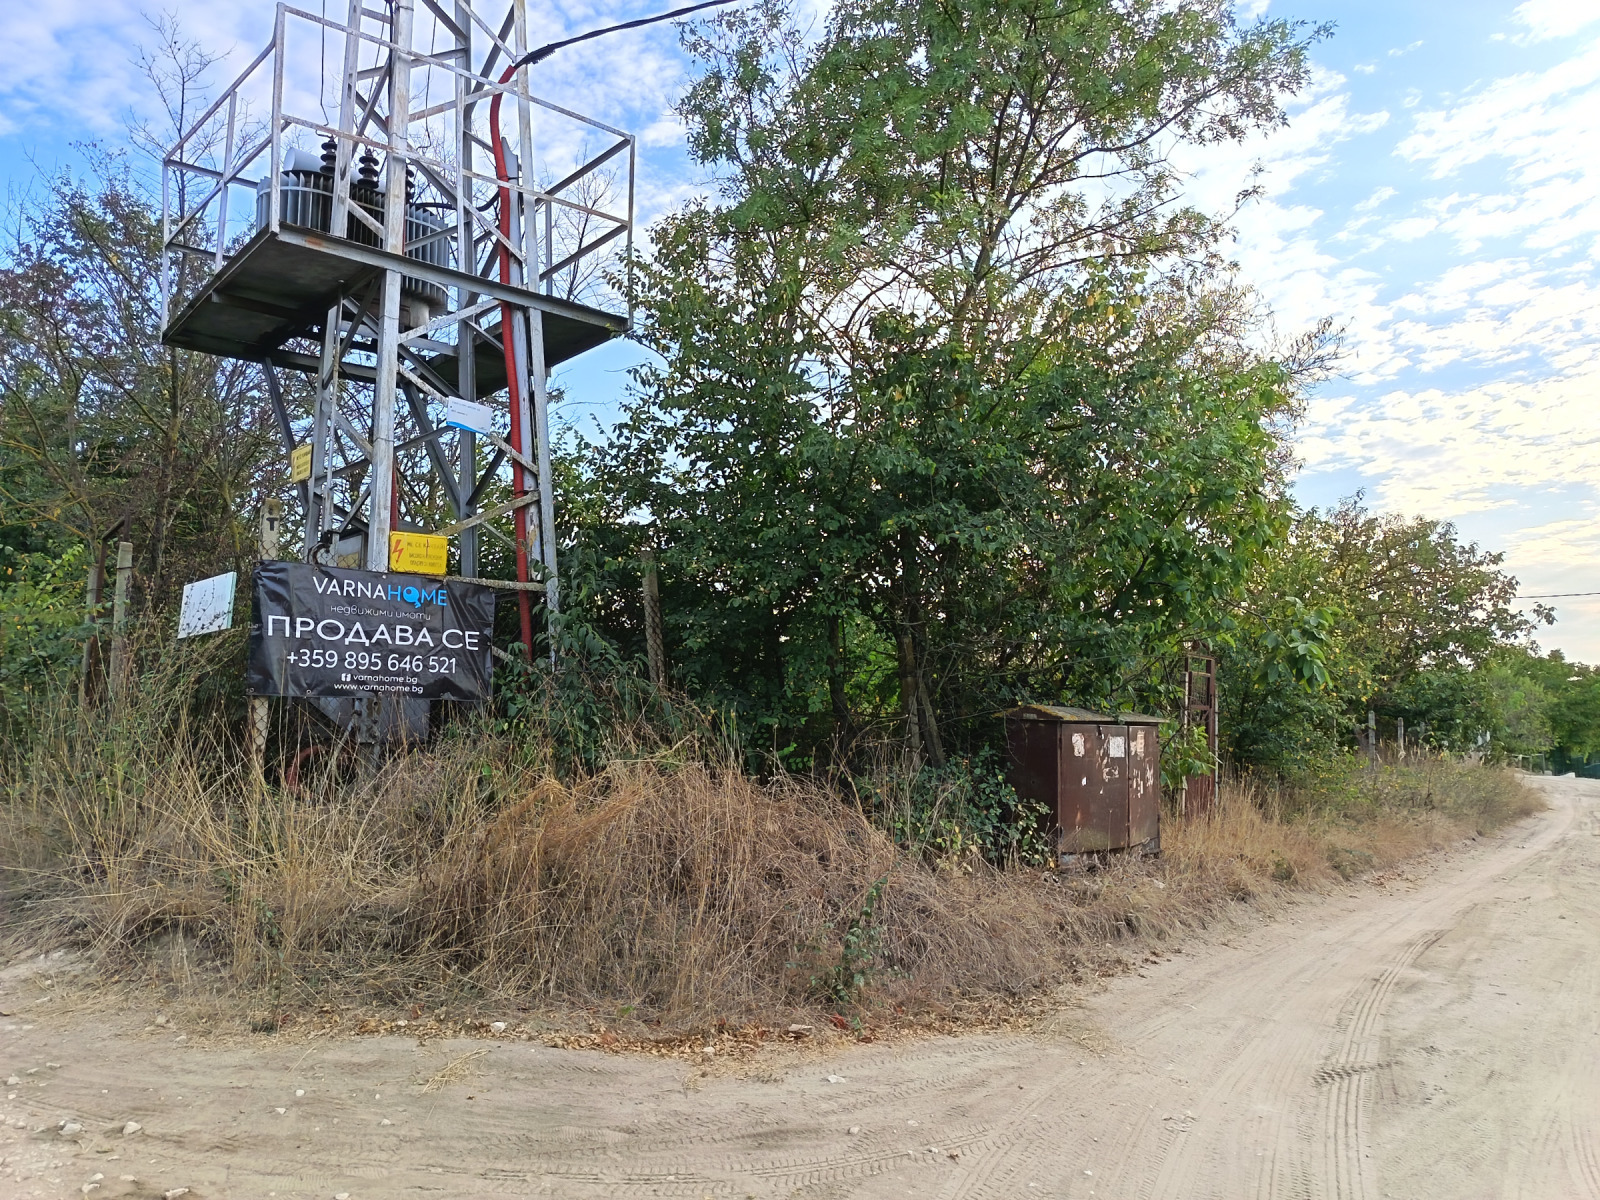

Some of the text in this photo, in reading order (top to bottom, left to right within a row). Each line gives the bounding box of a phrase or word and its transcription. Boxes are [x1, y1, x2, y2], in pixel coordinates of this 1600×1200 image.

[330, 605, 431, 620] недвижими имоти
[267, 615, 480, 650] ПРОДАВА СЕ
[287, 649, 456, 674] +359 895 646 521
[353, 674, 418, 684] varnahome.bg
[334, 683, 424, 694] www.varnahome.bg
